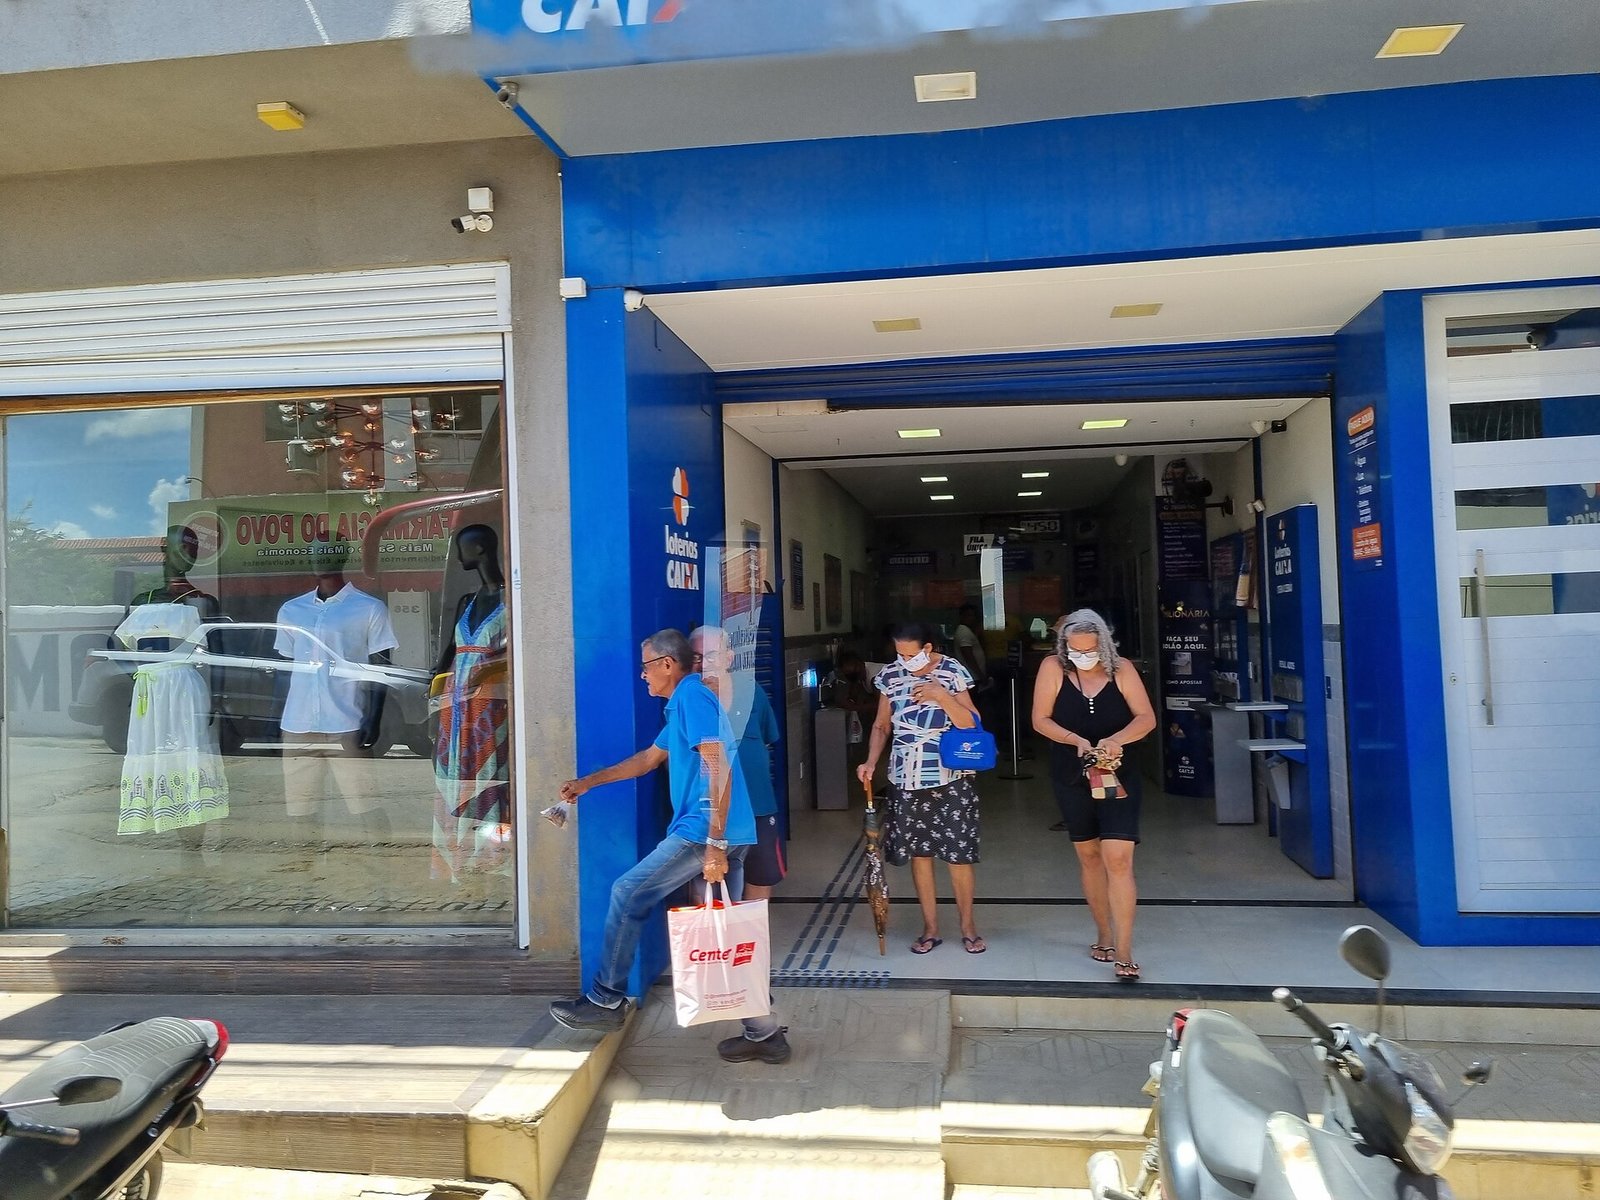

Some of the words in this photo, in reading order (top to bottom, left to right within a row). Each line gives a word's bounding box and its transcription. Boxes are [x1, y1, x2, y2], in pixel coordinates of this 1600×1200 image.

[664, 524, 698, 559] loterias
[666, 560, 699, 590] CAIXA
[1275, 559, 1292, 576] CAIXA
